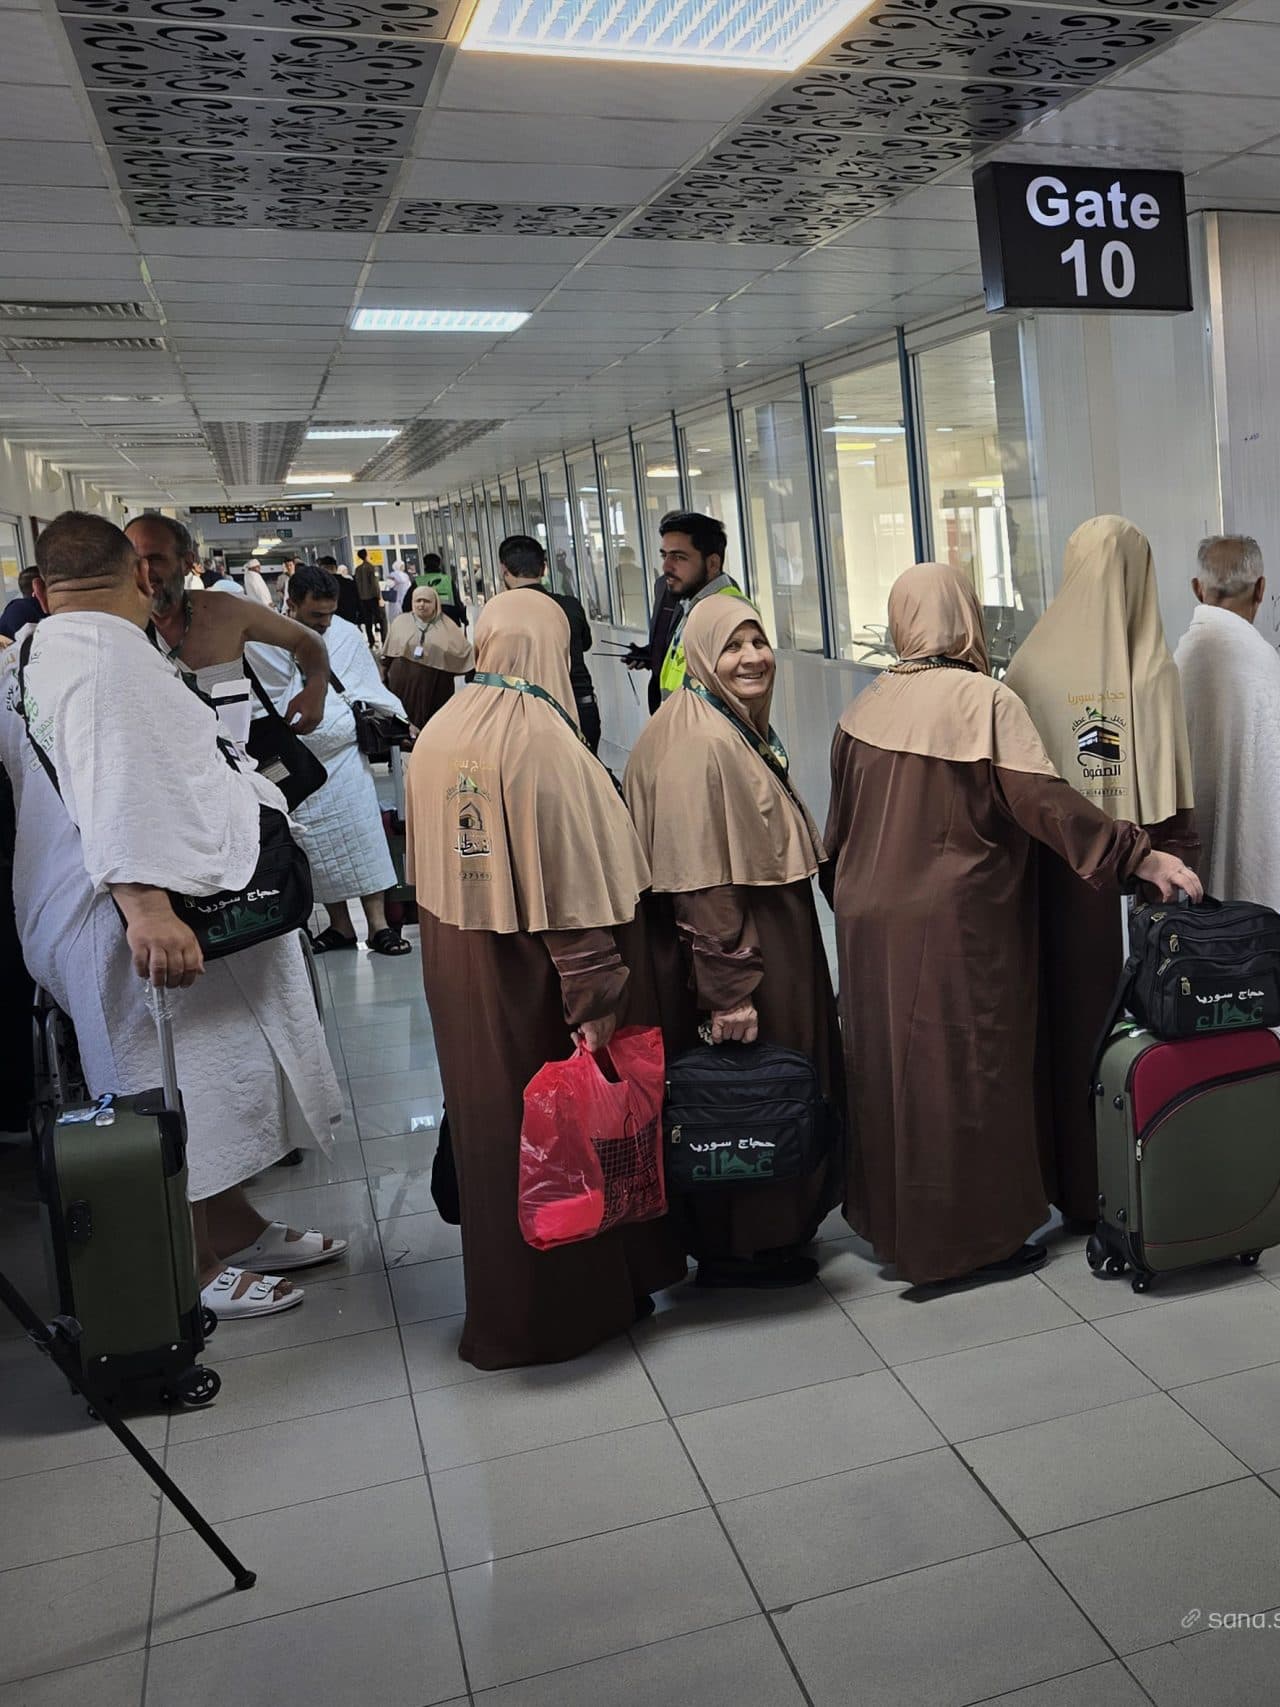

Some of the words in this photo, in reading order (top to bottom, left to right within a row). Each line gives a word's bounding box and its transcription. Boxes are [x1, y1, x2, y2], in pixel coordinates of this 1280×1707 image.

[1026, 176, 1161, 230] Gate
[1060, 239, 1136, 298] 10
[246, 888, 280, 902] حجاج
[197, 896, 241, 913] سوريا
[1195, 993, 1233, 1004] سوريا
[1238, 988, 1265, 1000] حجاج
[689, 1140, 732, 1153] سوريا
[738, 1137, 776, 1149] حجاج
